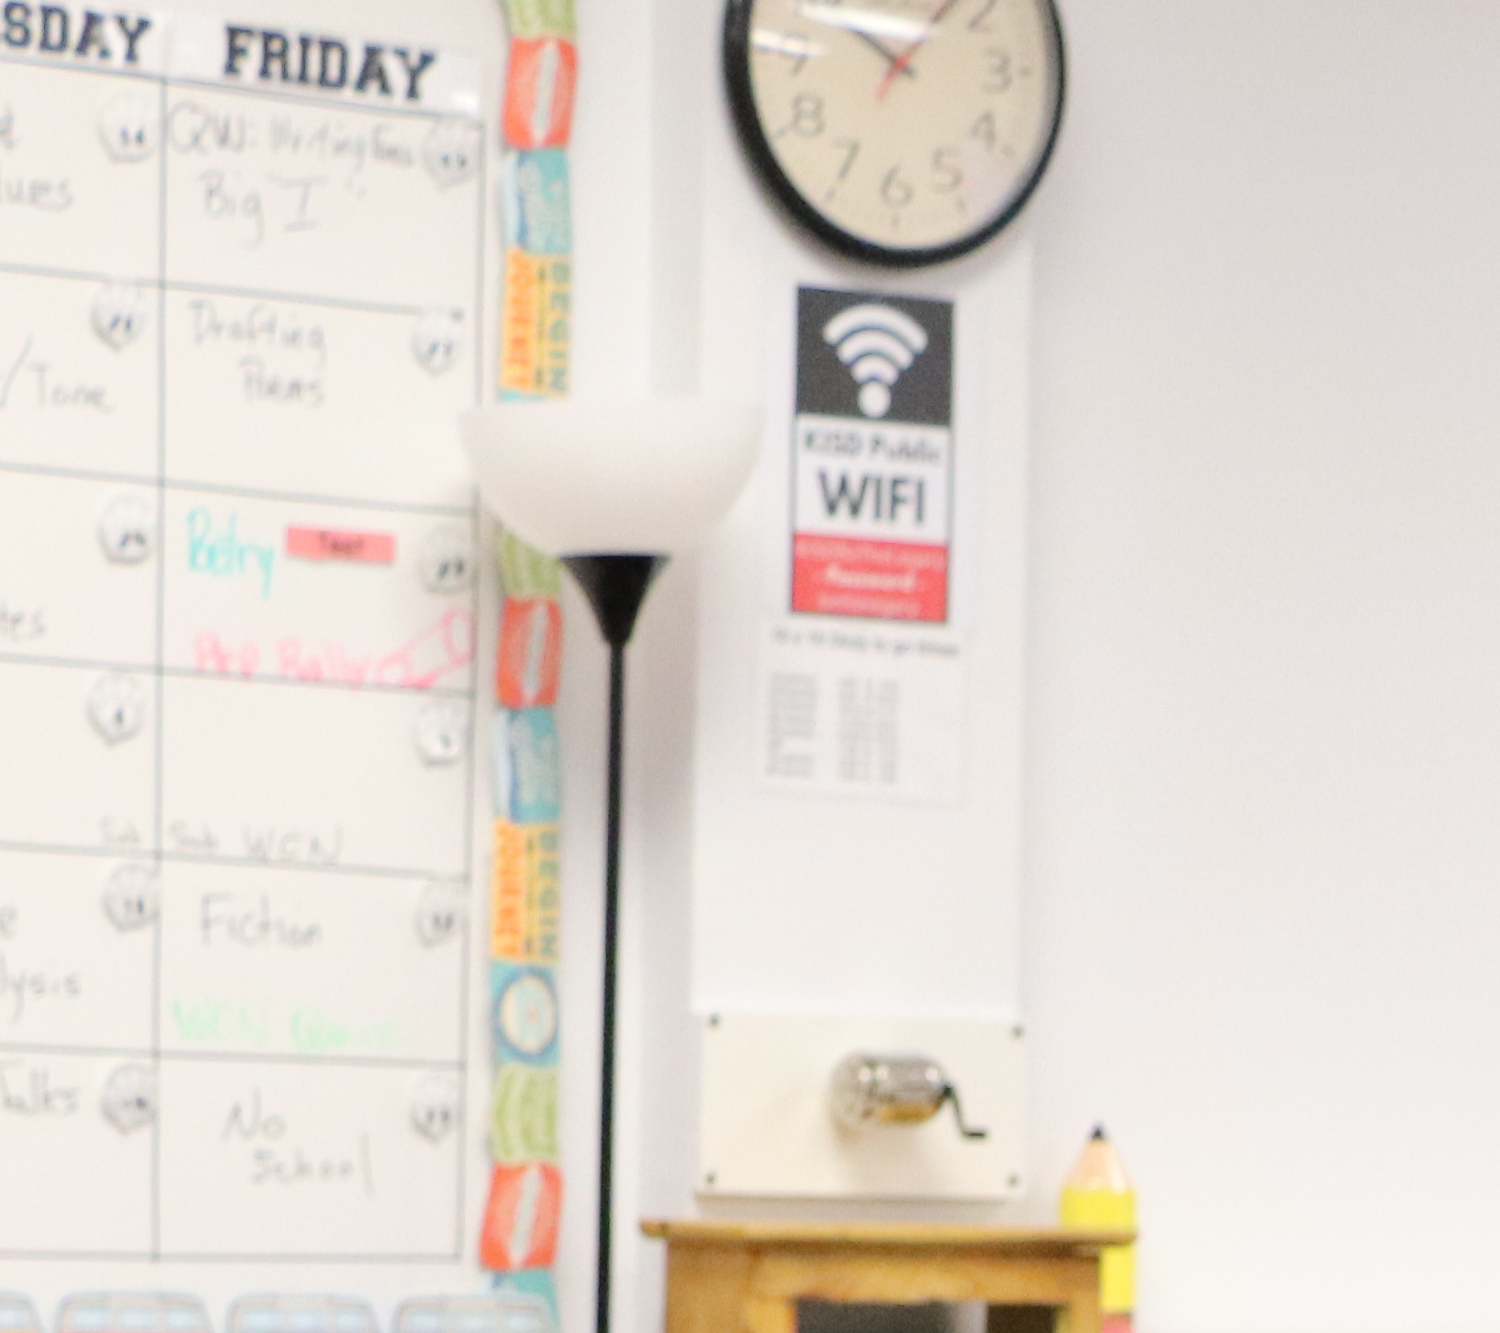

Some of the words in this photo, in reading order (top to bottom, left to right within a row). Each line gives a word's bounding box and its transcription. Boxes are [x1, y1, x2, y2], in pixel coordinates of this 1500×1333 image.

[225, 24, 436, 99] FRIDAY
[982, 46, 1014, 94] 3
[789, 90, 827, 138] 8
[968, 107, 997, 152] 4
[833, 135, 861, 184] 7
[878, 162, 916, 210] 6
[930, 144, 964, 195] 5
[199, 168, 265, 250] Big
[188, 299, 329, 370] Drafting
[814, 465, 928, 529] WIFI
[187, 507, 276, 601] Poetry
[200, 890, 324, 951] Fiction
[221, 1086, 287, 1143] No
[248, 1132, 374, 1200] School
